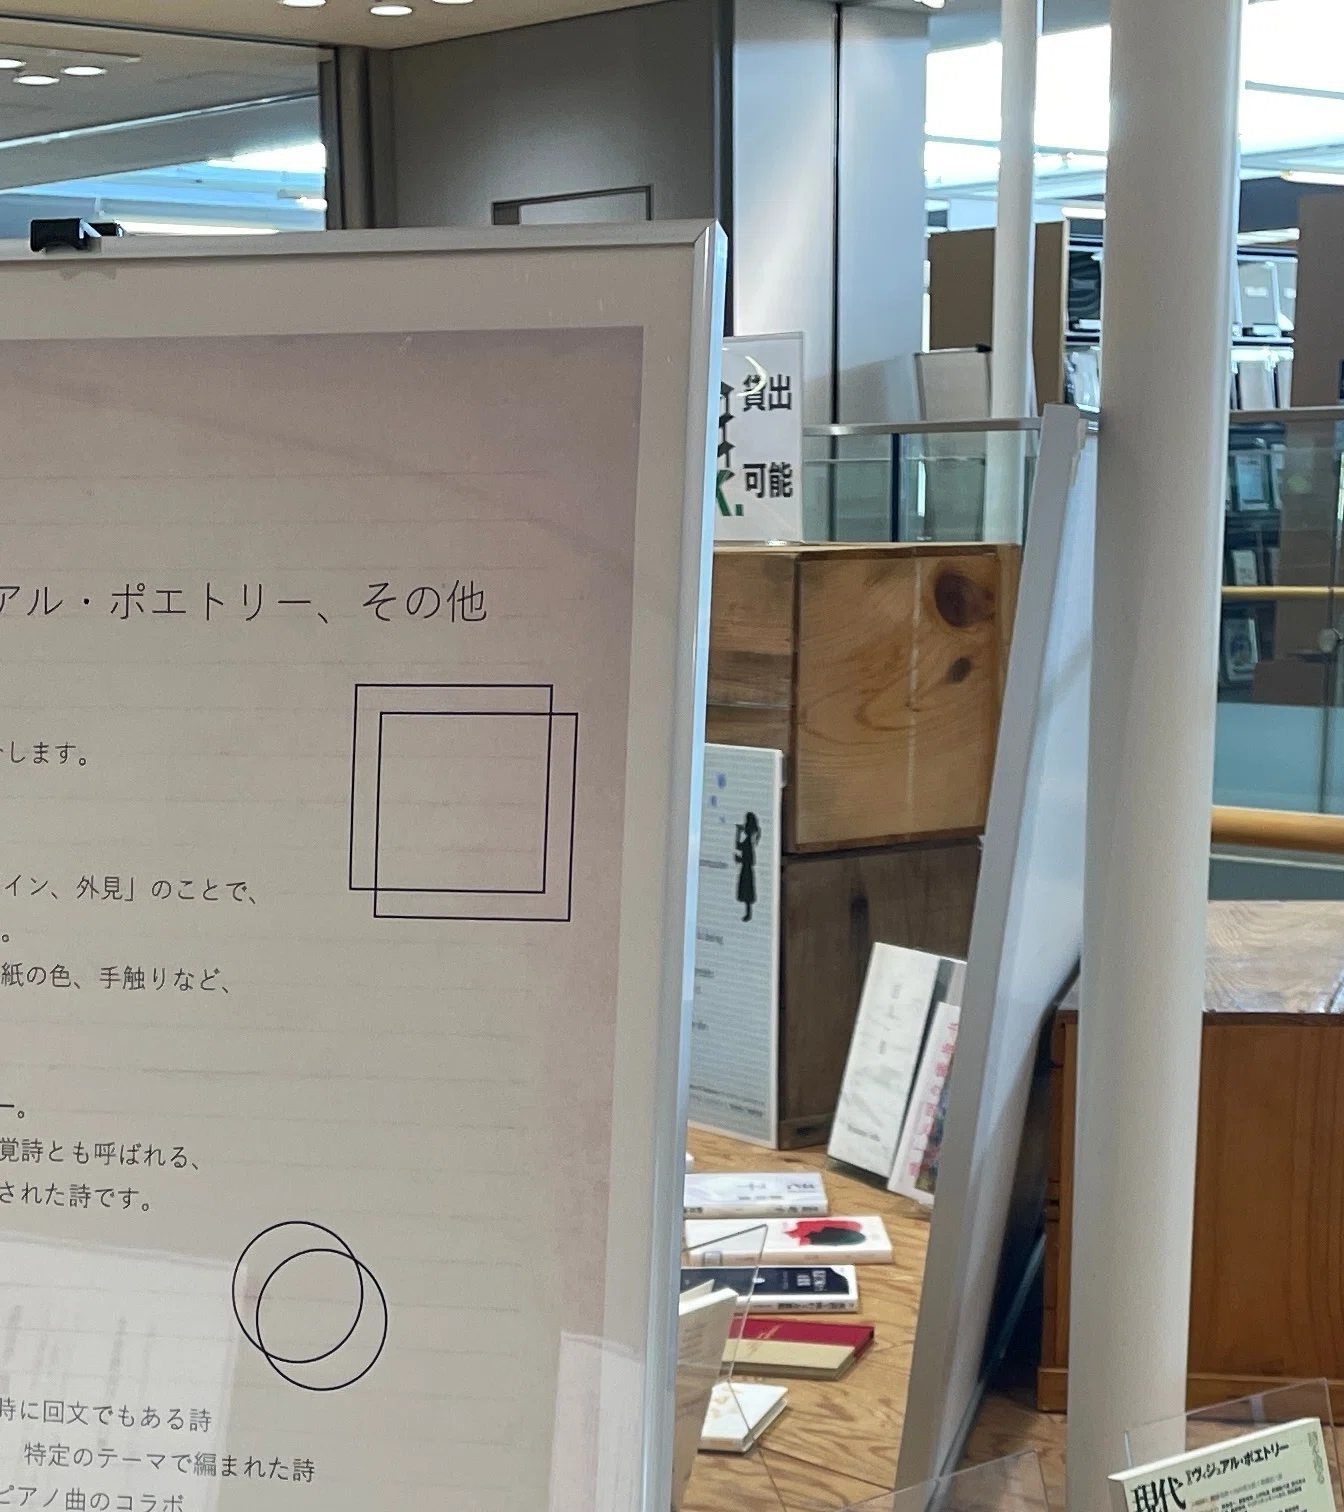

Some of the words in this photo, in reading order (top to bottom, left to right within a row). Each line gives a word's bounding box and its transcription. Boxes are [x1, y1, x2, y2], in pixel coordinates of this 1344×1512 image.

[743, 461, 793, 498] 可能
[24, 1442, 315, 1483] 特定のテーマで編まれた詩
